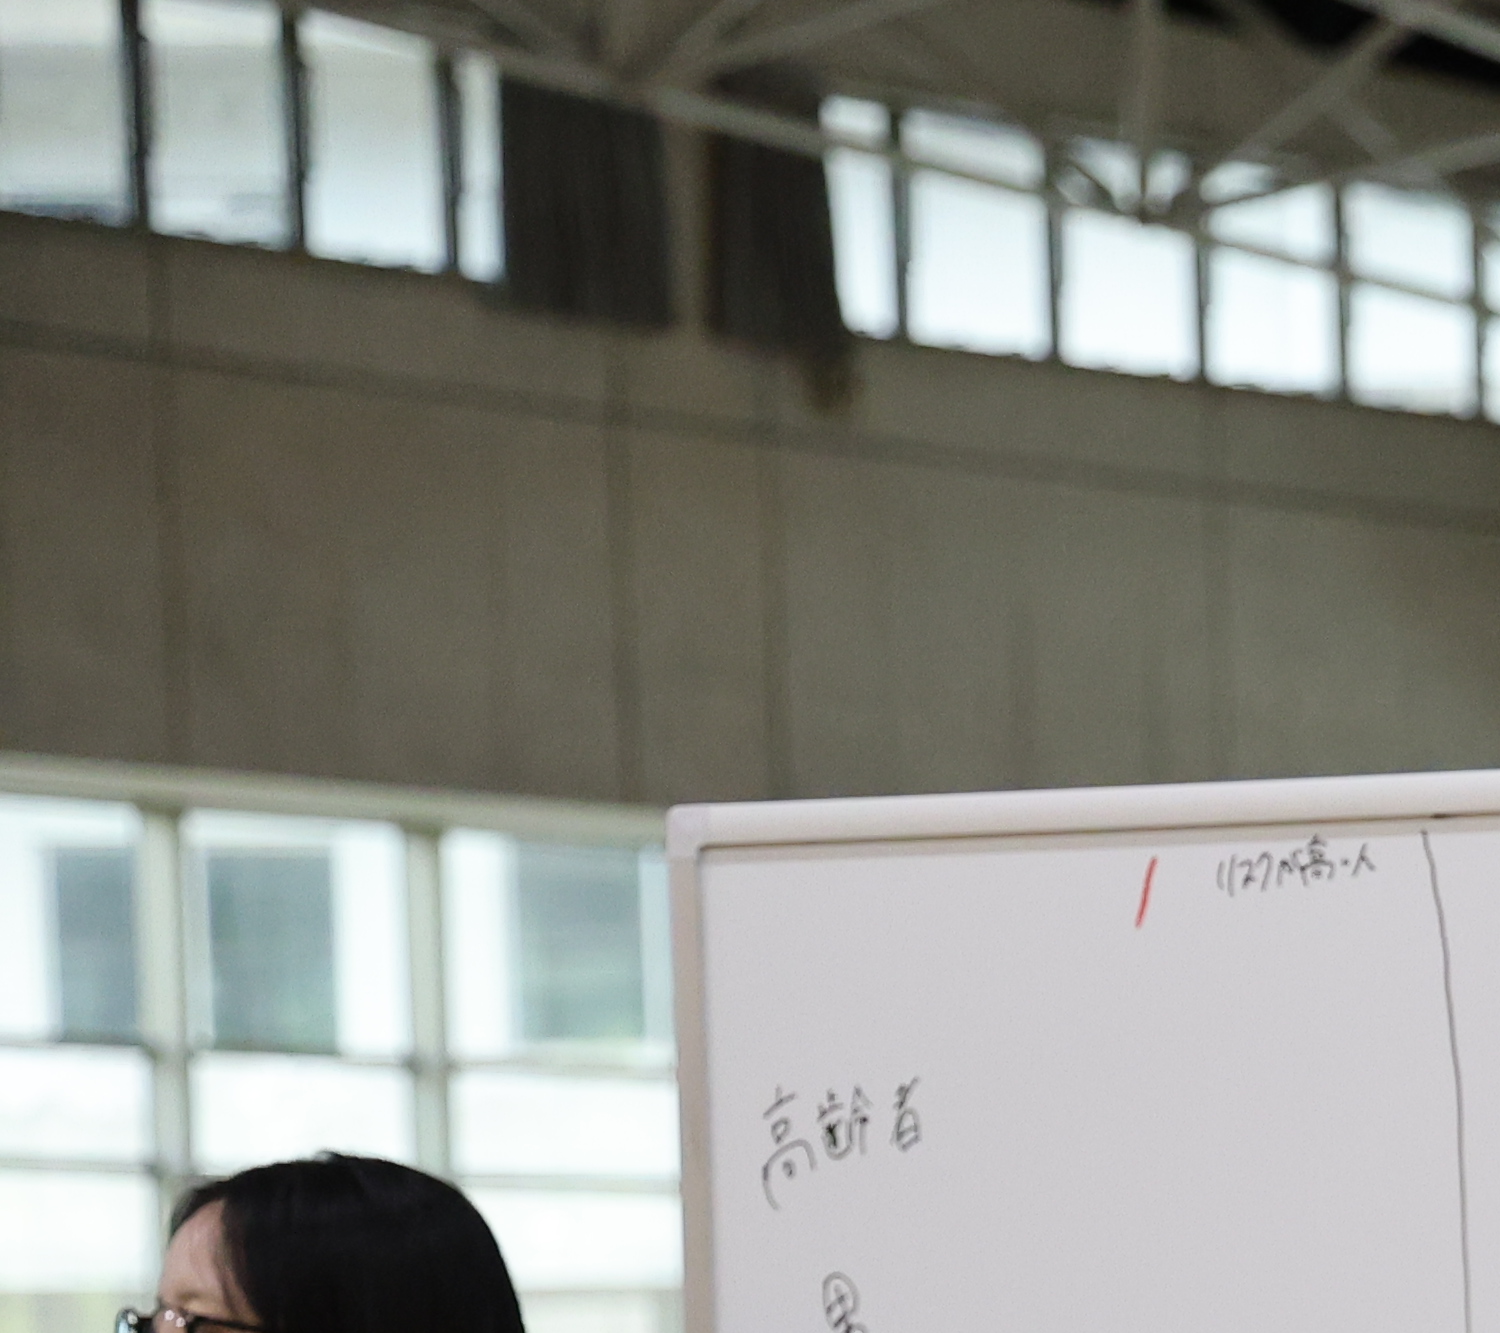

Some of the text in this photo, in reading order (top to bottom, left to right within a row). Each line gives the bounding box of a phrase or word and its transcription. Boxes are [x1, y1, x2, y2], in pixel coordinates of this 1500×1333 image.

[1135, 856, 1158, 928] 1
[762, 1077, 922, 1210] 高齢者
